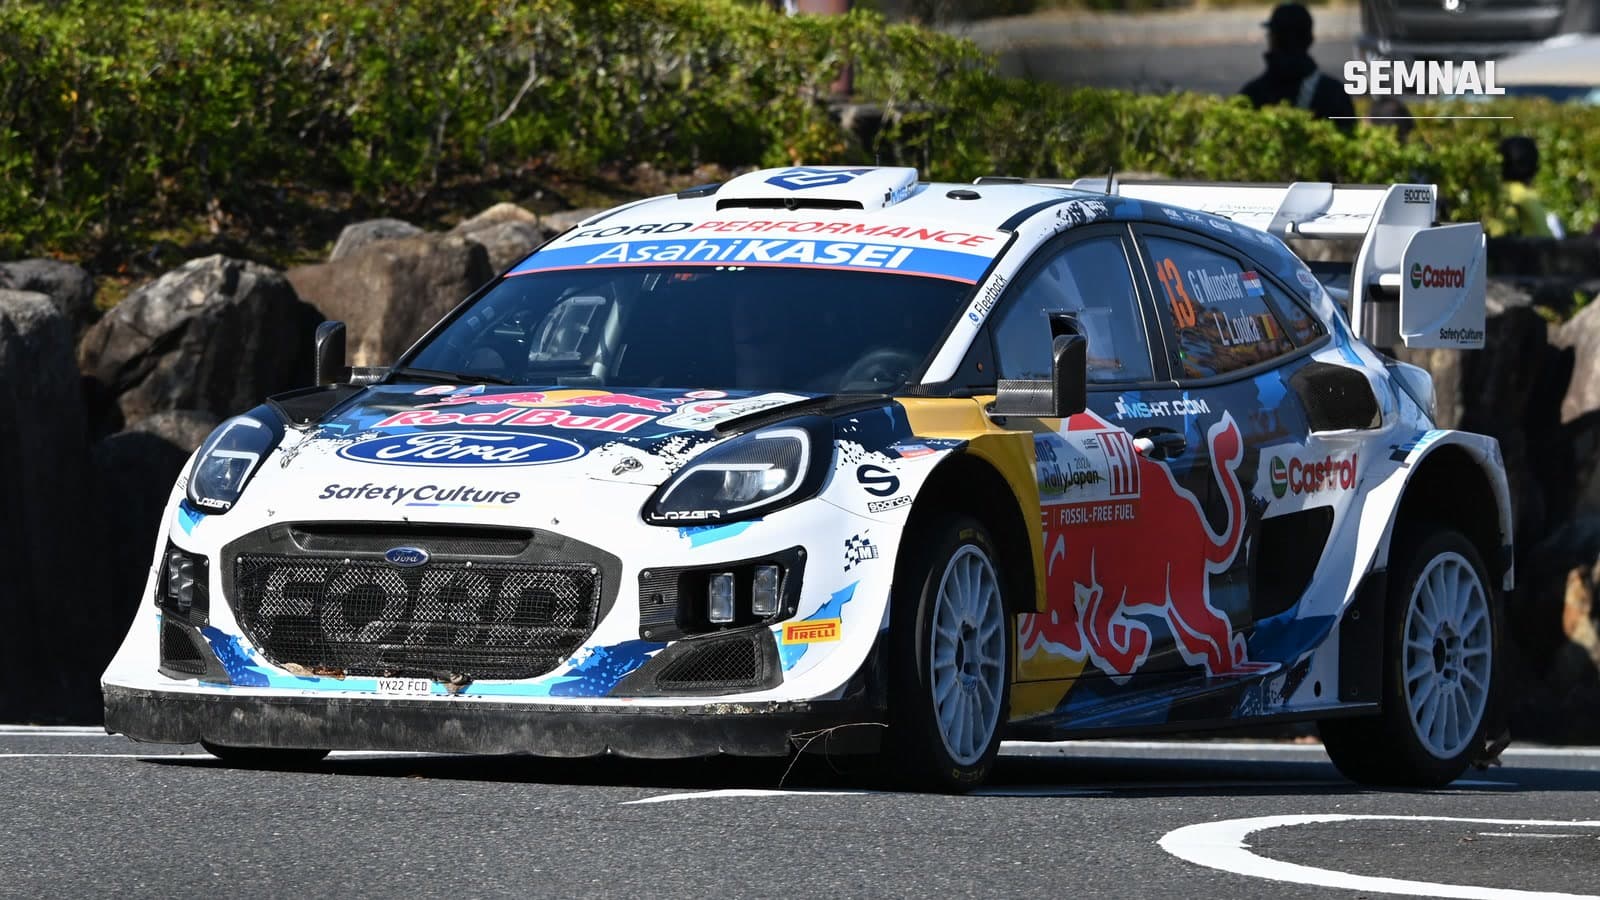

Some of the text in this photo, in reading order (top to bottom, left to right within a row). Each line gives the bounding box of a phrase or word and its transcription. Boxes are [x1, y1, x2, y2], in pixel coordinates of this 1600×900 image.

[1404, 189, 1431, 201] sparco
[1199, 266, 1245, 303] Munster
[1422, 265, 1466, 289] Castrol
[1156, 258, 1196, 329] 13
[1222, 309, 1261, 345] Louka
[1440, 328, 1484, 342] SafetyCulture
[374, 408, 656, 433] Red Bull
[375, 433, 548, 463] Ford
[1288, 453, 1357, 495] Castrol
[319, 483, 521, 507] SafetyCulture
[651, 508, 721, 520] LAZER
[1060, 506, 1113, 526] FOSSIL-FREE
[1114, 504, 1135, 521] FUEL
[252, 565, 580, 649] FORD
[786, 622, 836, 641] PIRELLI
[379, 679, 428, 692] YX22 FCD
